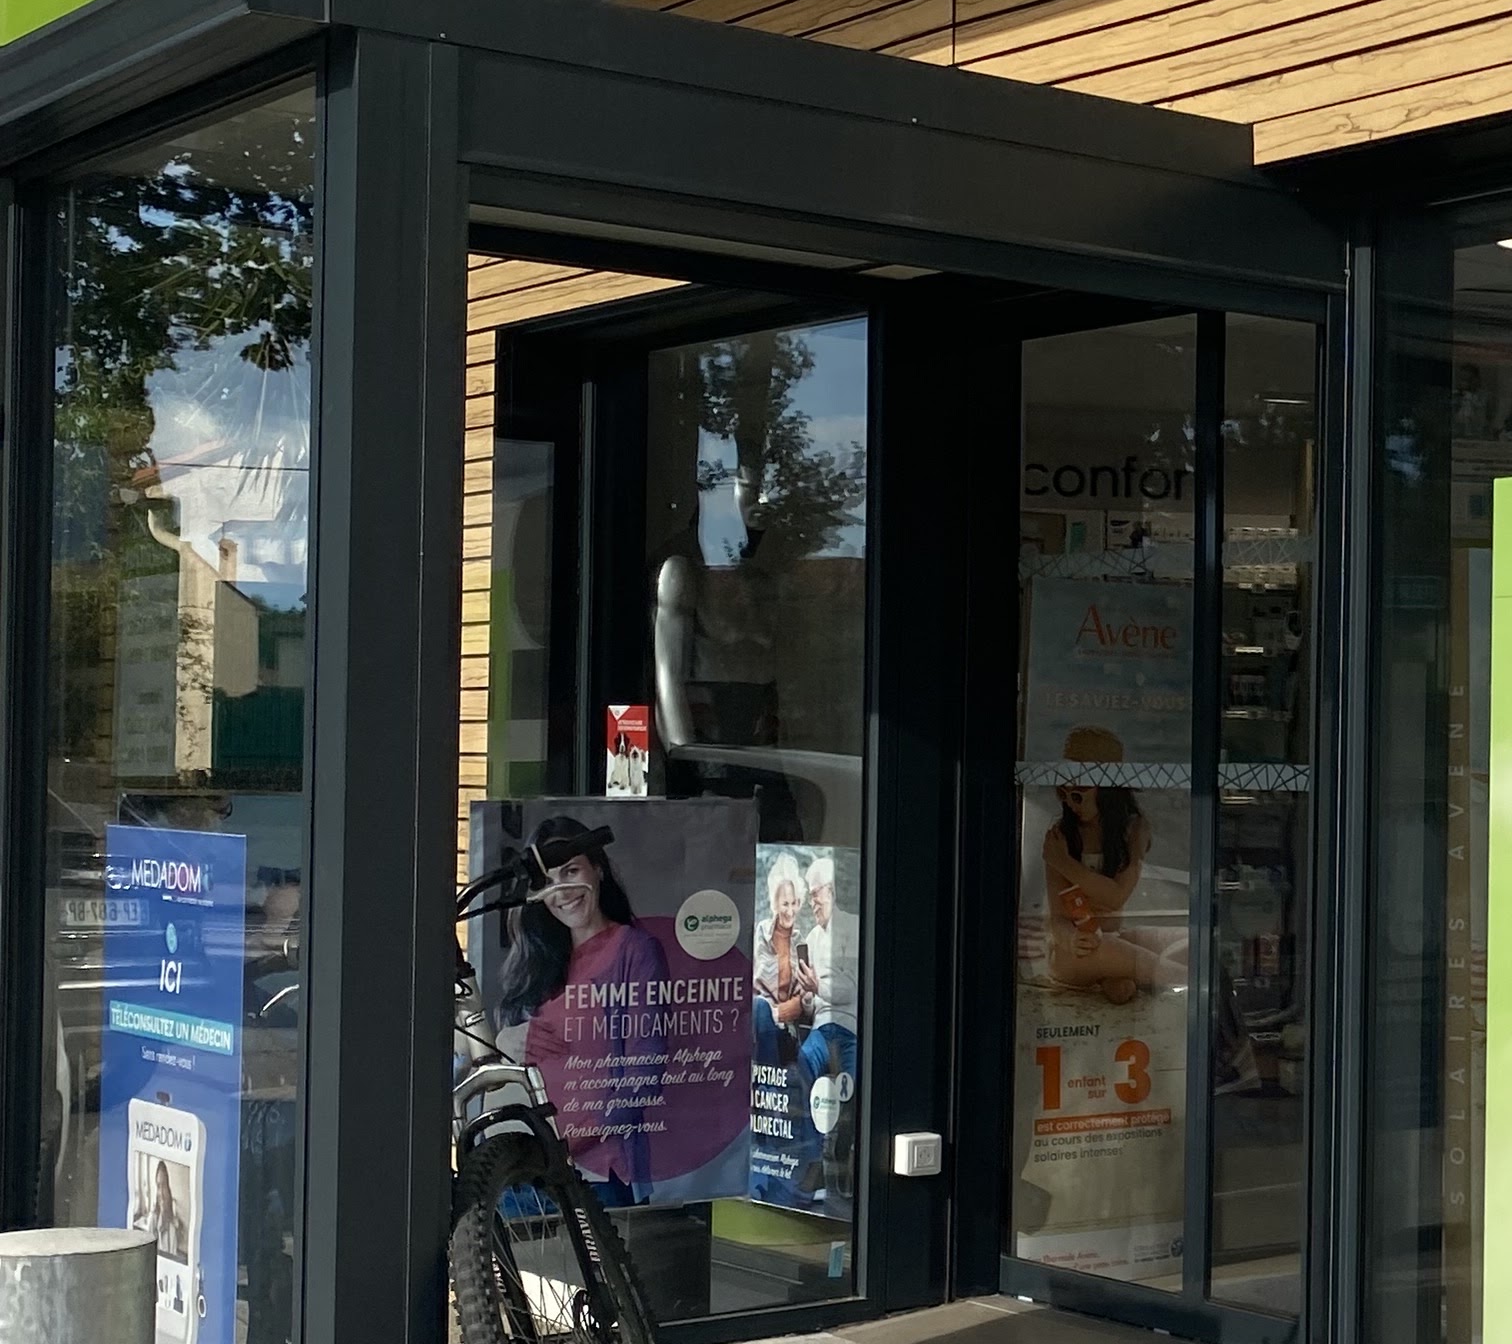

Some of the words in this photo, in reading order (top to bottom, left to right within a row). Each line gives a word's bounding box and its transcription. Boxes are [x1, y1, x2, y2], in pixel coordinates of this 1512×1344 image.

[1024, 456, 1194, 501] confor
[1074, 601, 1178, 651] Avène
[1448, 685, 1465, 860] AVENE
[131, 859, 202, 893] MEDADOM
[159, 959, 183, 994] ICI
[565, 982, 640, 1009] FEMME
[646, 977, 744, 1006] ENCEINTE
[111, 1002, 175, 1037] TÉLÉCONSULTEZ
[175, 1025, 190, 1041] UN
[190, 1020, 231, 1051] MÉDECIN
[564, 1016, 585, 1042] ET
[592, 1008, 724, 1041] MÉDICAMENTS
[730, 1008, 740, 1032] ?
[1036, 1024, 1101, 1039] SEULEMENT
[564, 1055, 594, 1070] Mon
[592, 1052, 670, 1071] pharmacien
[672, 1046, 723, 1068] Alphega
[1114, 1039, 1152, 1105] 3
[1450, 917, 1465, 1205] SOLAIRES
[564, 1073, 659, 1093] m'accompagne
[660, 1070, 687, 1085] tout
[688, 1072, 705, 1083] au
[706, 1067, 735, 1087] long
[1036, 1045, 1061, 1111] 1
[1067, 1074, 1106, 1089] enfant
[1087, 1088, 1107, 1099] sur
[563, 1097, 580, 1112] de
[581, 1100, 605, 1111] ma
[606, 1095, 667, 1117] grossesse.
[136, 1120, 183, 1150] MEDADOM
[563, 1120, 668, 1143] Renseignez-vous.
[1034, 1137, 1049, 1147] au
[1051, 1135, 1082, 1146] cours
[1084, 1131, 1104, 1143] des
[1106, 1127, 1163, 1142] expositions
[1037, 1121, 1054, 1132] est
[1056, 1115, 1129, 1131] correctement
[1034, 1150, 1078, 1163] solaires
[1079, 1146, 1124, 1159] intenses
